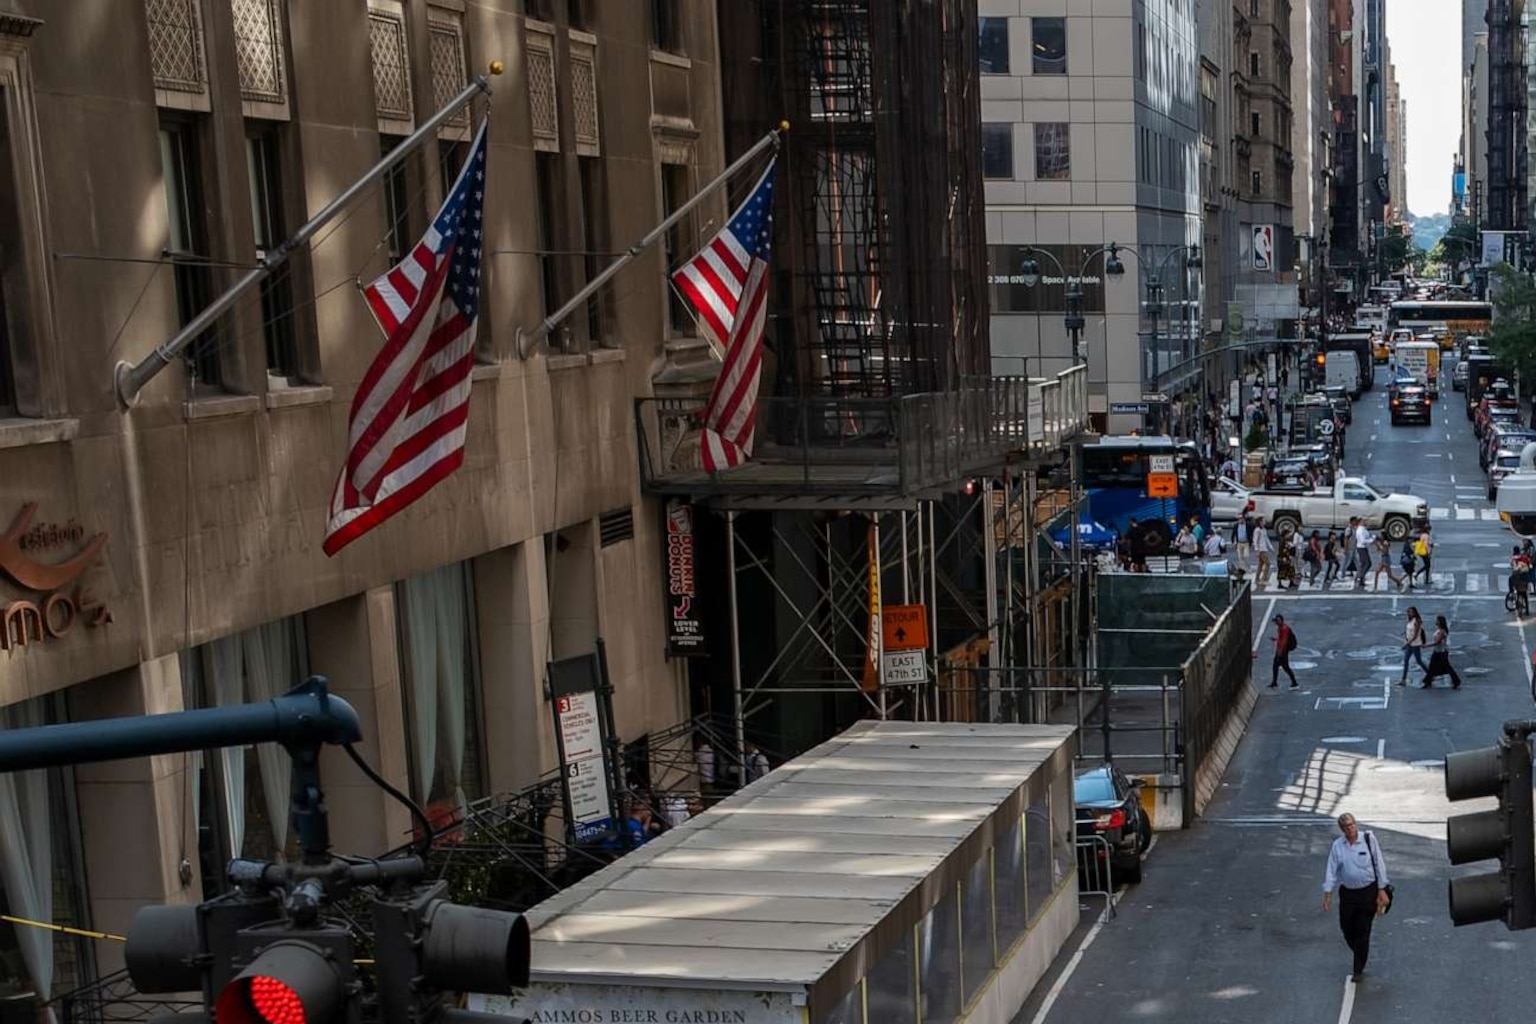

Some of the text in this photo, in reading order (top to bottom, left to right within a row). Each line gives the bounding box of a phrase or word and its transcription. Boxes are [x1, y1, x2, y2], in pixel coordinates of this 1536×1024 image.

[669, 534, 682, 595] DONUTS
[892, 656, 914, 667] EAST
[560, 699, 569, 712] 3
[569, 763, 577, 777] 6
[531, 1009, 746, 1024] AMMOS BEER GARDEN
